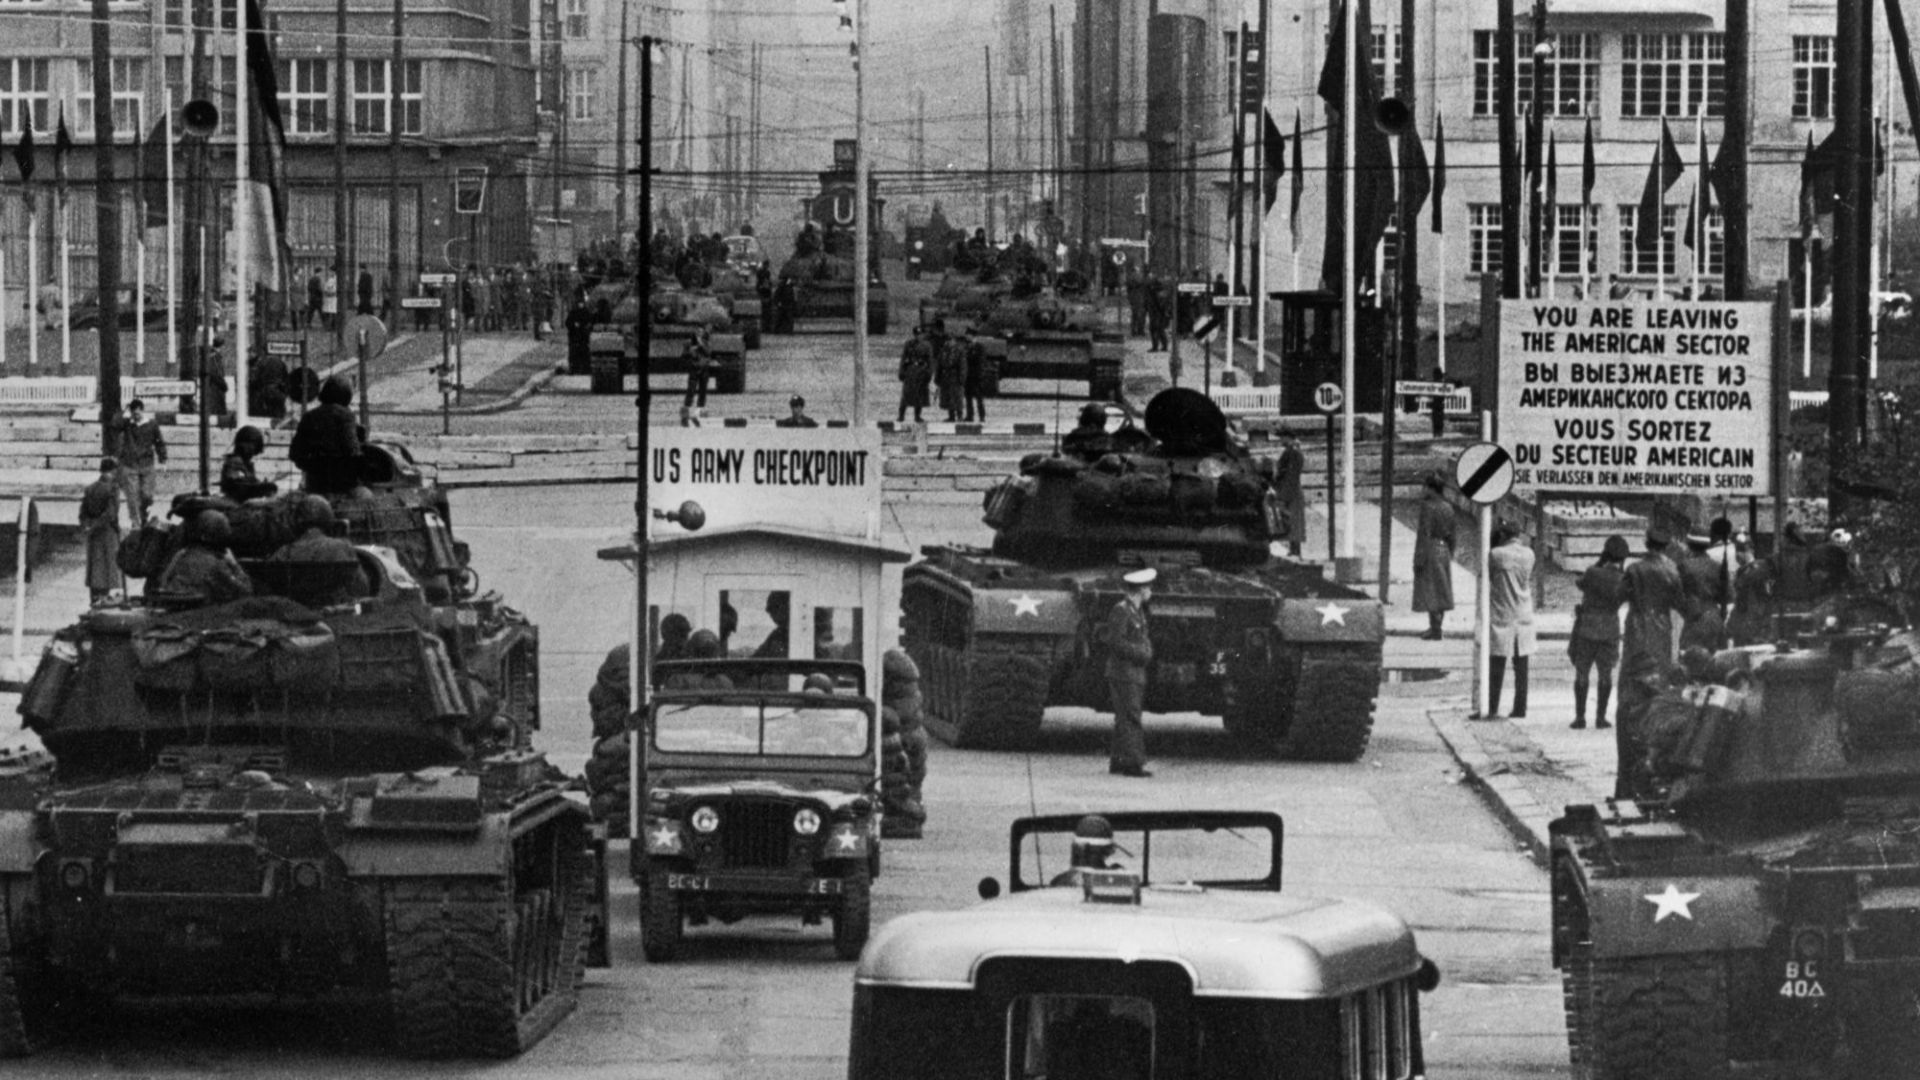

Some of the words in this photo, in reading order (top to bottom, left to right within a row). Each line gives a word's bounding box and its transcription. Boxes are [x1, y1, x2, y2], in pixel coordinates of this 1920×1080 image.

[1533, 306, 1577, 327] YOU
[1589, 308, 1633, 328] ARE
[1647, 309, 1738, 330] LEAVING
[1522, 332, 1555, 352] THE
[1565, 333, 1665, 354] AMERICAN
[1676, 334, 1749, 355] SECTOR
[1525, 362, 1558, 383] ВЫ
[1571, 363, 1704, 384] ВЫЕЗЖАЕТЕ
[1718, 365, 1746, 386] ИЗ
[1320, 386, 1332, 406] 10
[1520, 388, 1667, 410] АМЕРИКАНСКОГО
[1675, 390, 1752, 410] СЕКТОРА
[1555, 419, 1614, 439] VOUS
[1628, 419, 1711, 442] SORTEZ
[692, 448, 744, 484] ARMY
[754, 449, 868, 486] CHECKPOINT
[1516, 444, 1540, 464] DU
[1552, 445, 1637, 465] SECTEUR
[1647, 447, 1754, 467] AMERICAIN
[1516, 470, 1530, 483] SIE
[1537, 470, 1593, 484] VERLASSEN
[1598, 472, 1618, 485] DEN
[1623, 473, 1710, 487] AMERIKANISCHEN
[1715, 474, 1753, 488] SEKTOR
